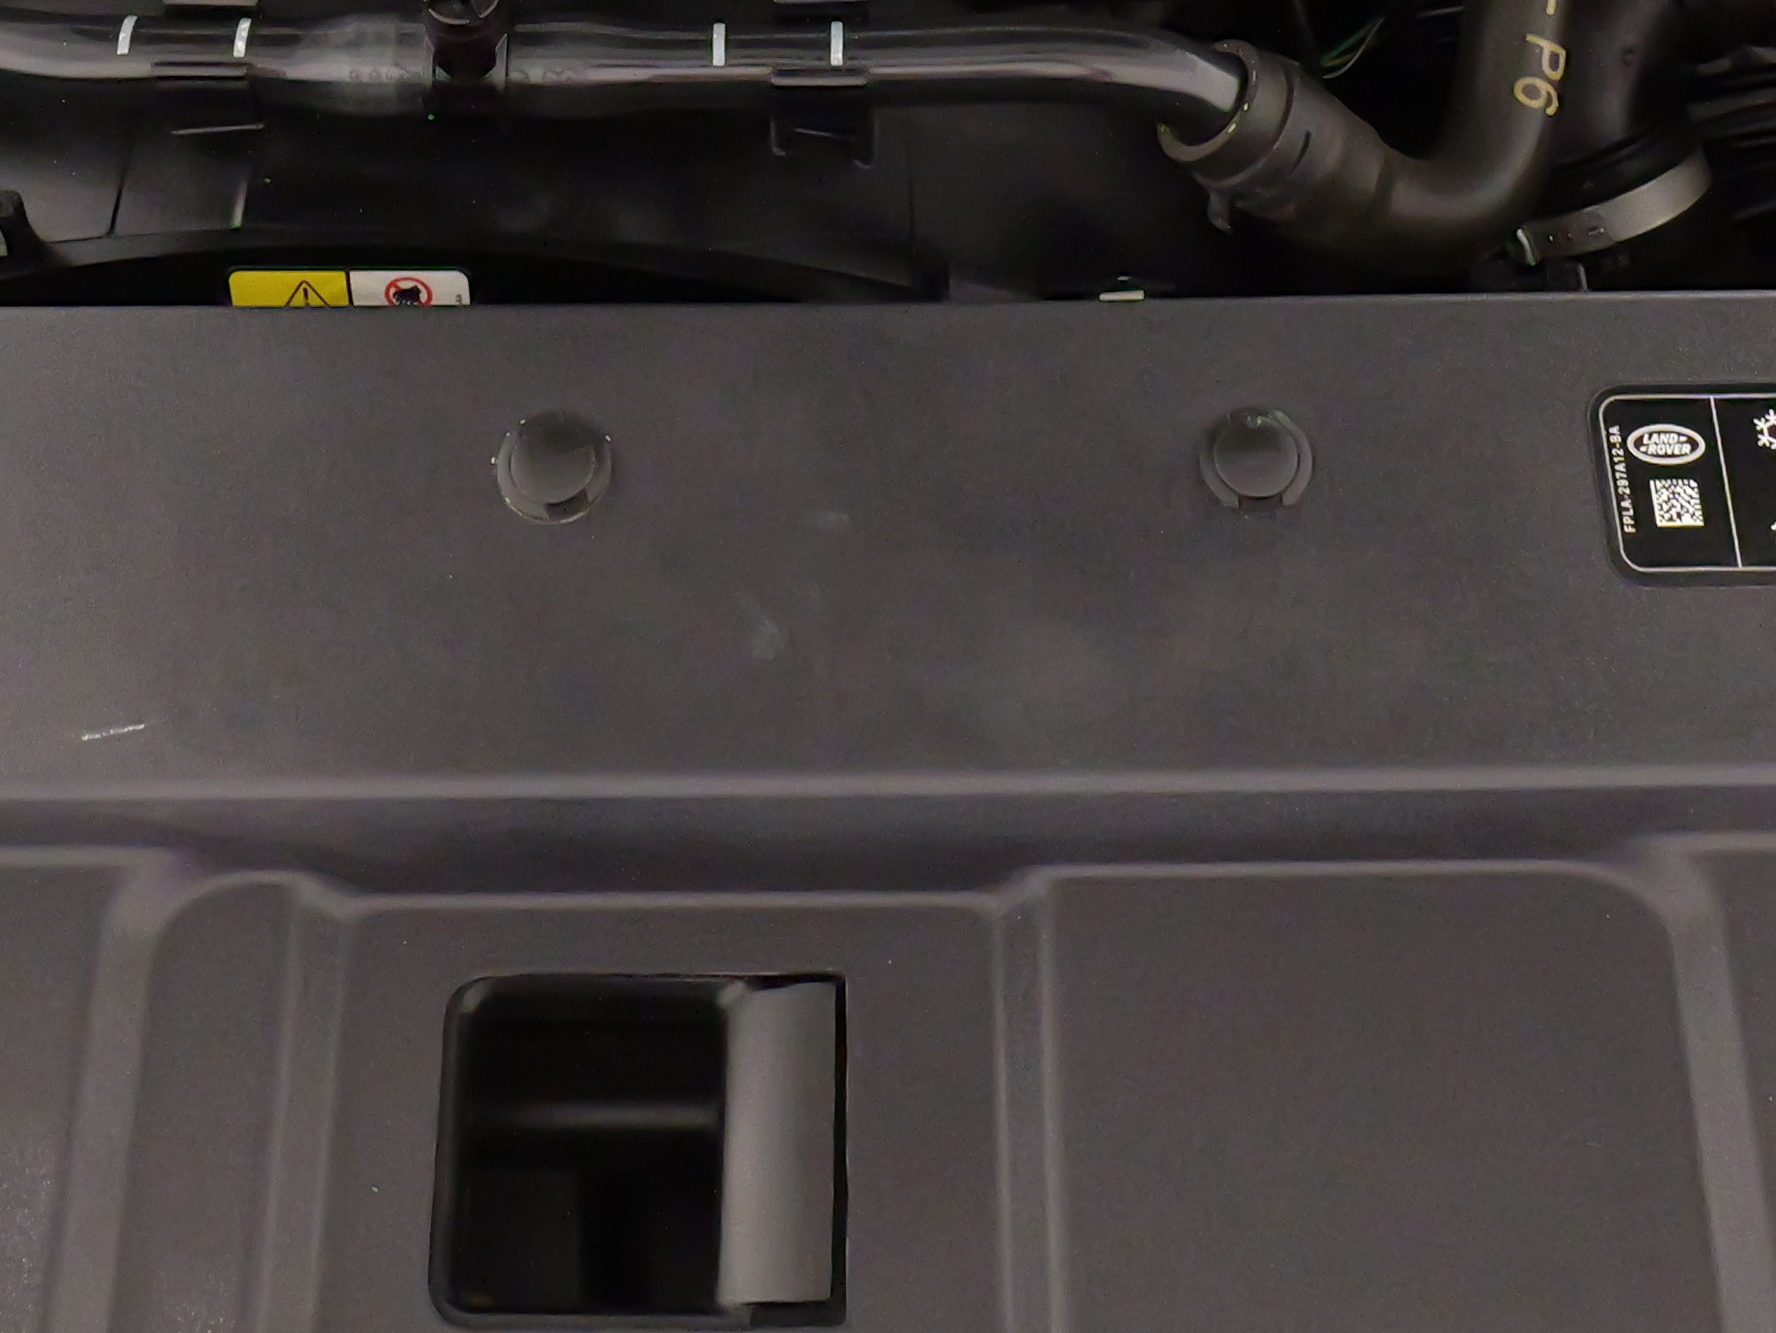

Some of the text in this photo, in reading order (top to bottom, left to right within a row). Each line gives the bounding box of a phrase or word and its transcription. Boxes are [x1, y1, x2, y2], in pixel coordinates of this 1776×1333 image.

[1513, 33, 1566, 116] P6
[1642, 433, 1680, 444] LAND
[1647, 443, 1691, 455] ROVER
